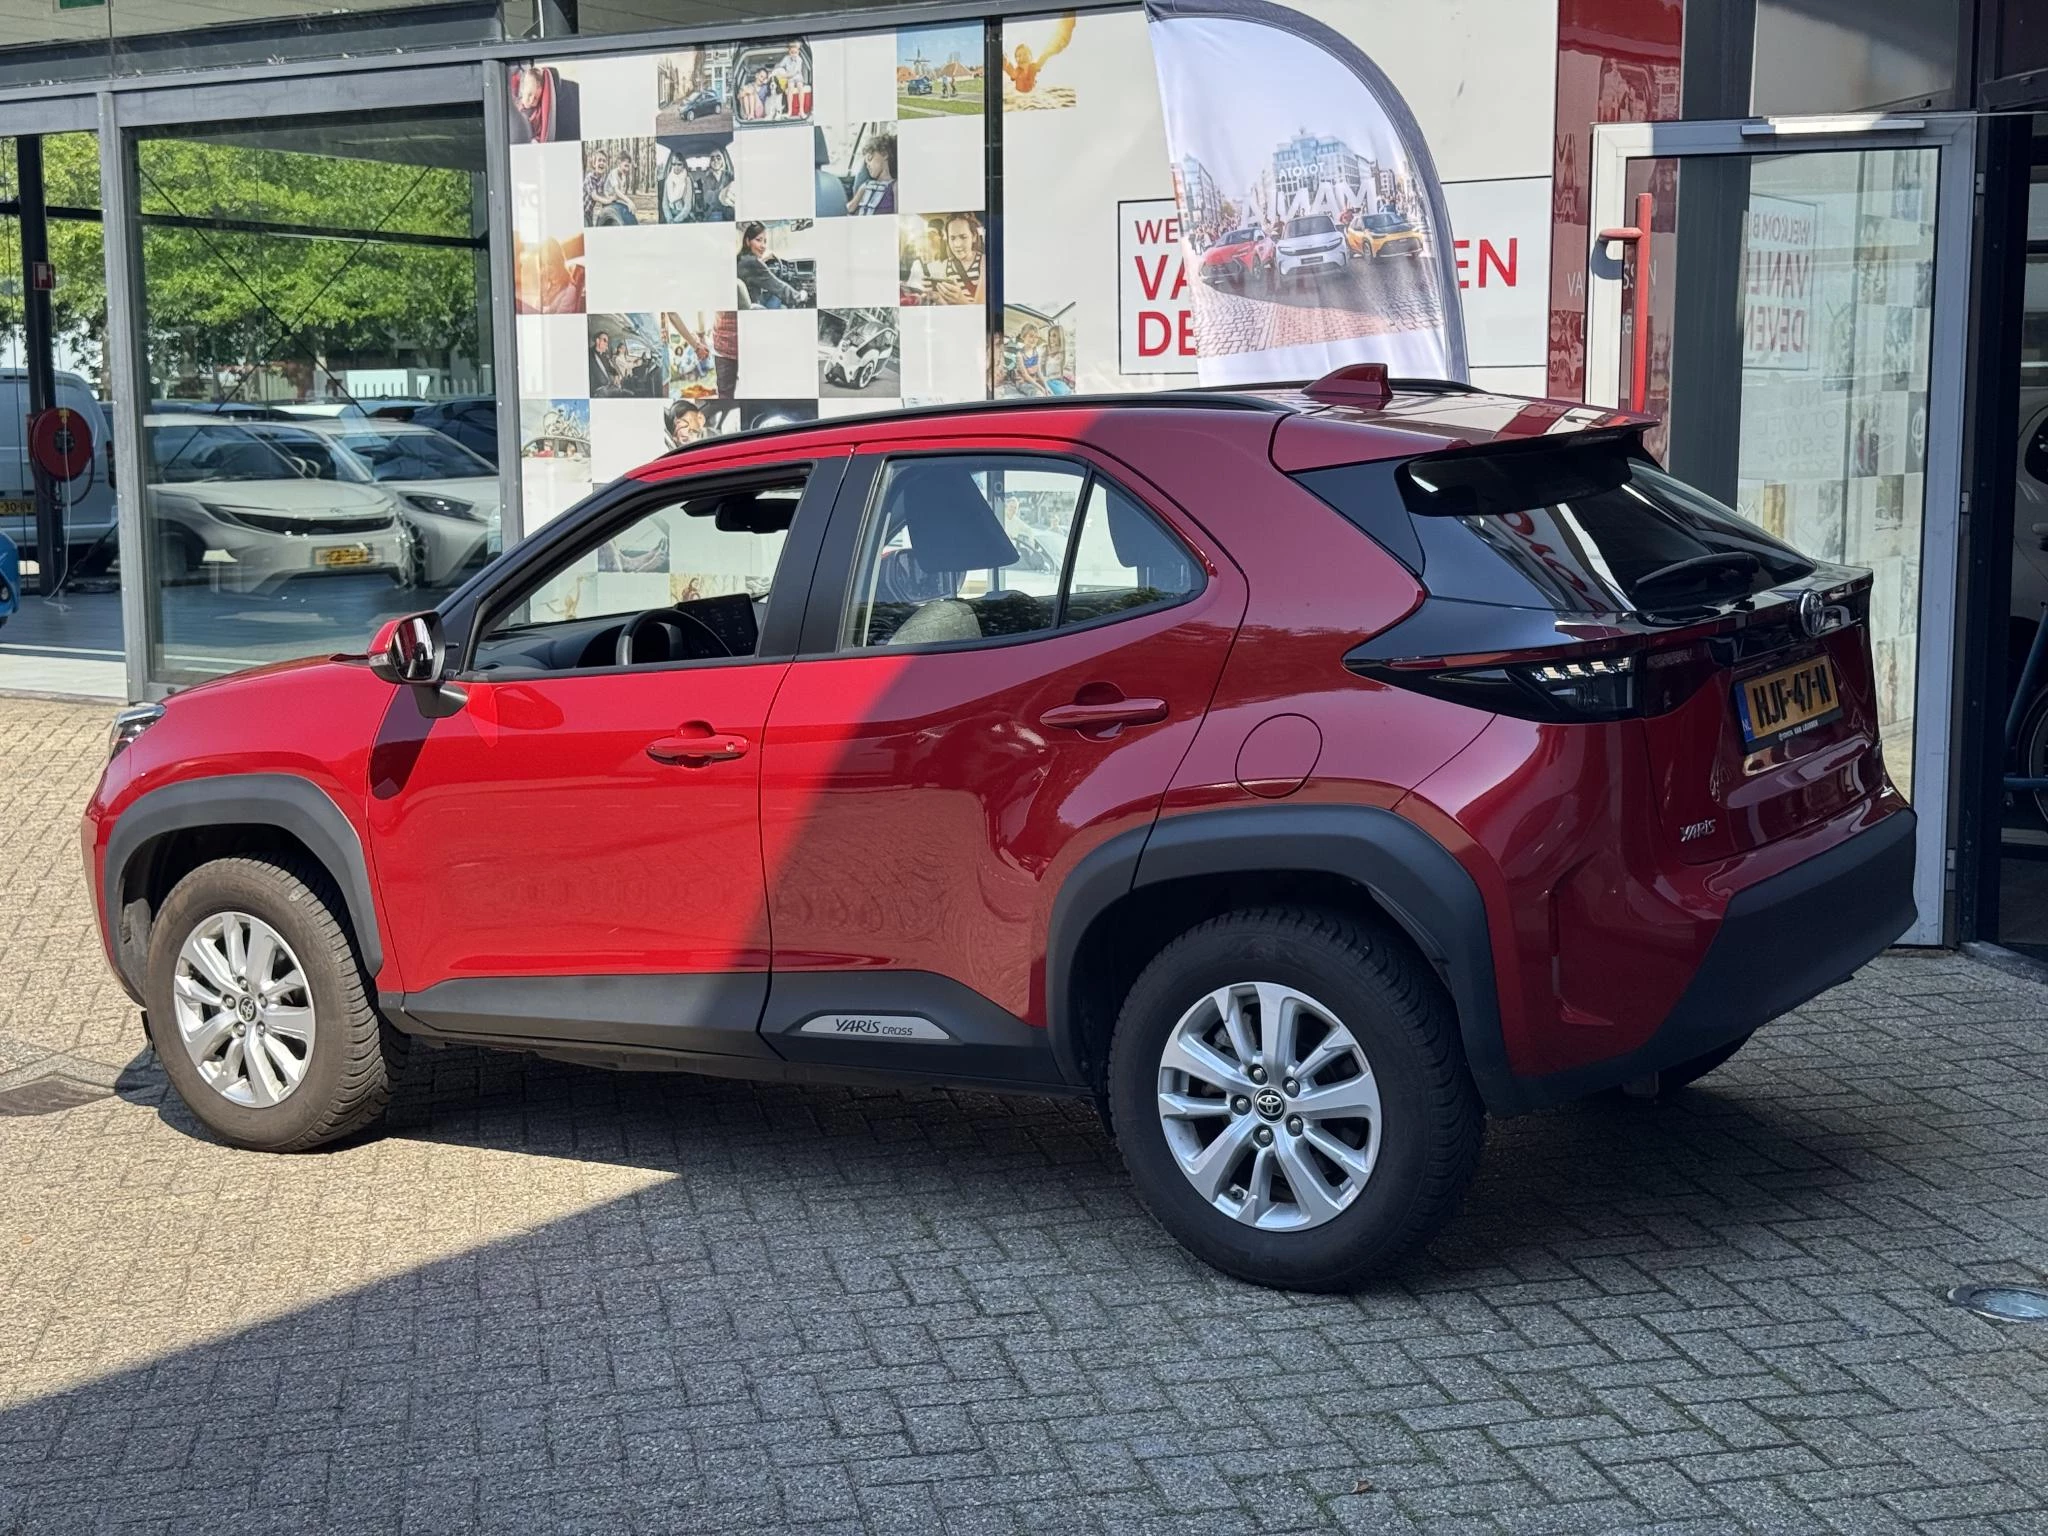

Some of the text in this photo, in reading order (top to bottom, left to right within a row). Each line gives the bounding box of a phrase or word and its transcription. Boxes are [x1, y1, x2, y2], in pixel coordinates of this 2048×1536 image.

[1135, 218, 1178, 245] WE
[1138, 310, 1197, 357] DE
[881, 1026, 913, 1036] CROSS
